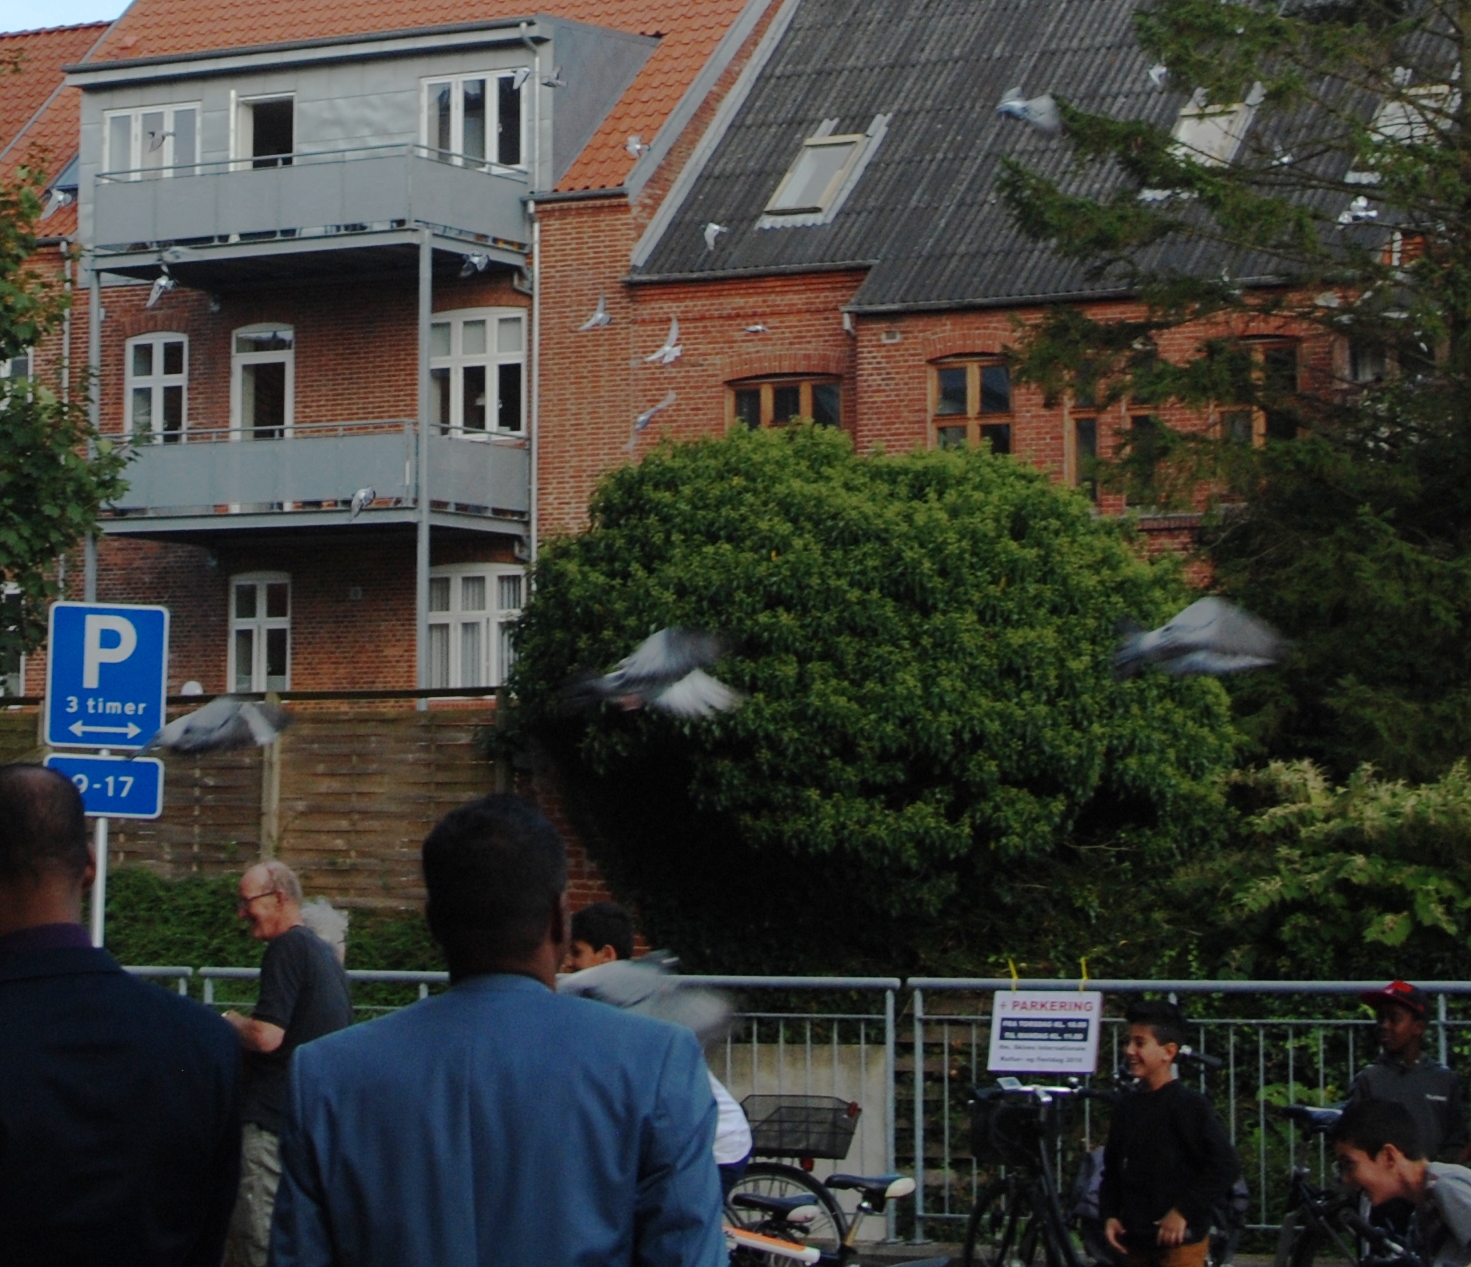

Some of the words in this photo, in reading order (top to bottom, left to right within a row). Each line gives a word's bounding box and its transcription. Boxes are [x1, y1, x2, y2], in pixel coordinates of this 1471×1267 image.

[82, 614, 137, 689] P
[65, 696, 79, 714] 3
[86, 697, 147, 715] timer
[71, 774, 134, 798] 9-17
[1012, 1000, 1093, 1012] PARKERING
